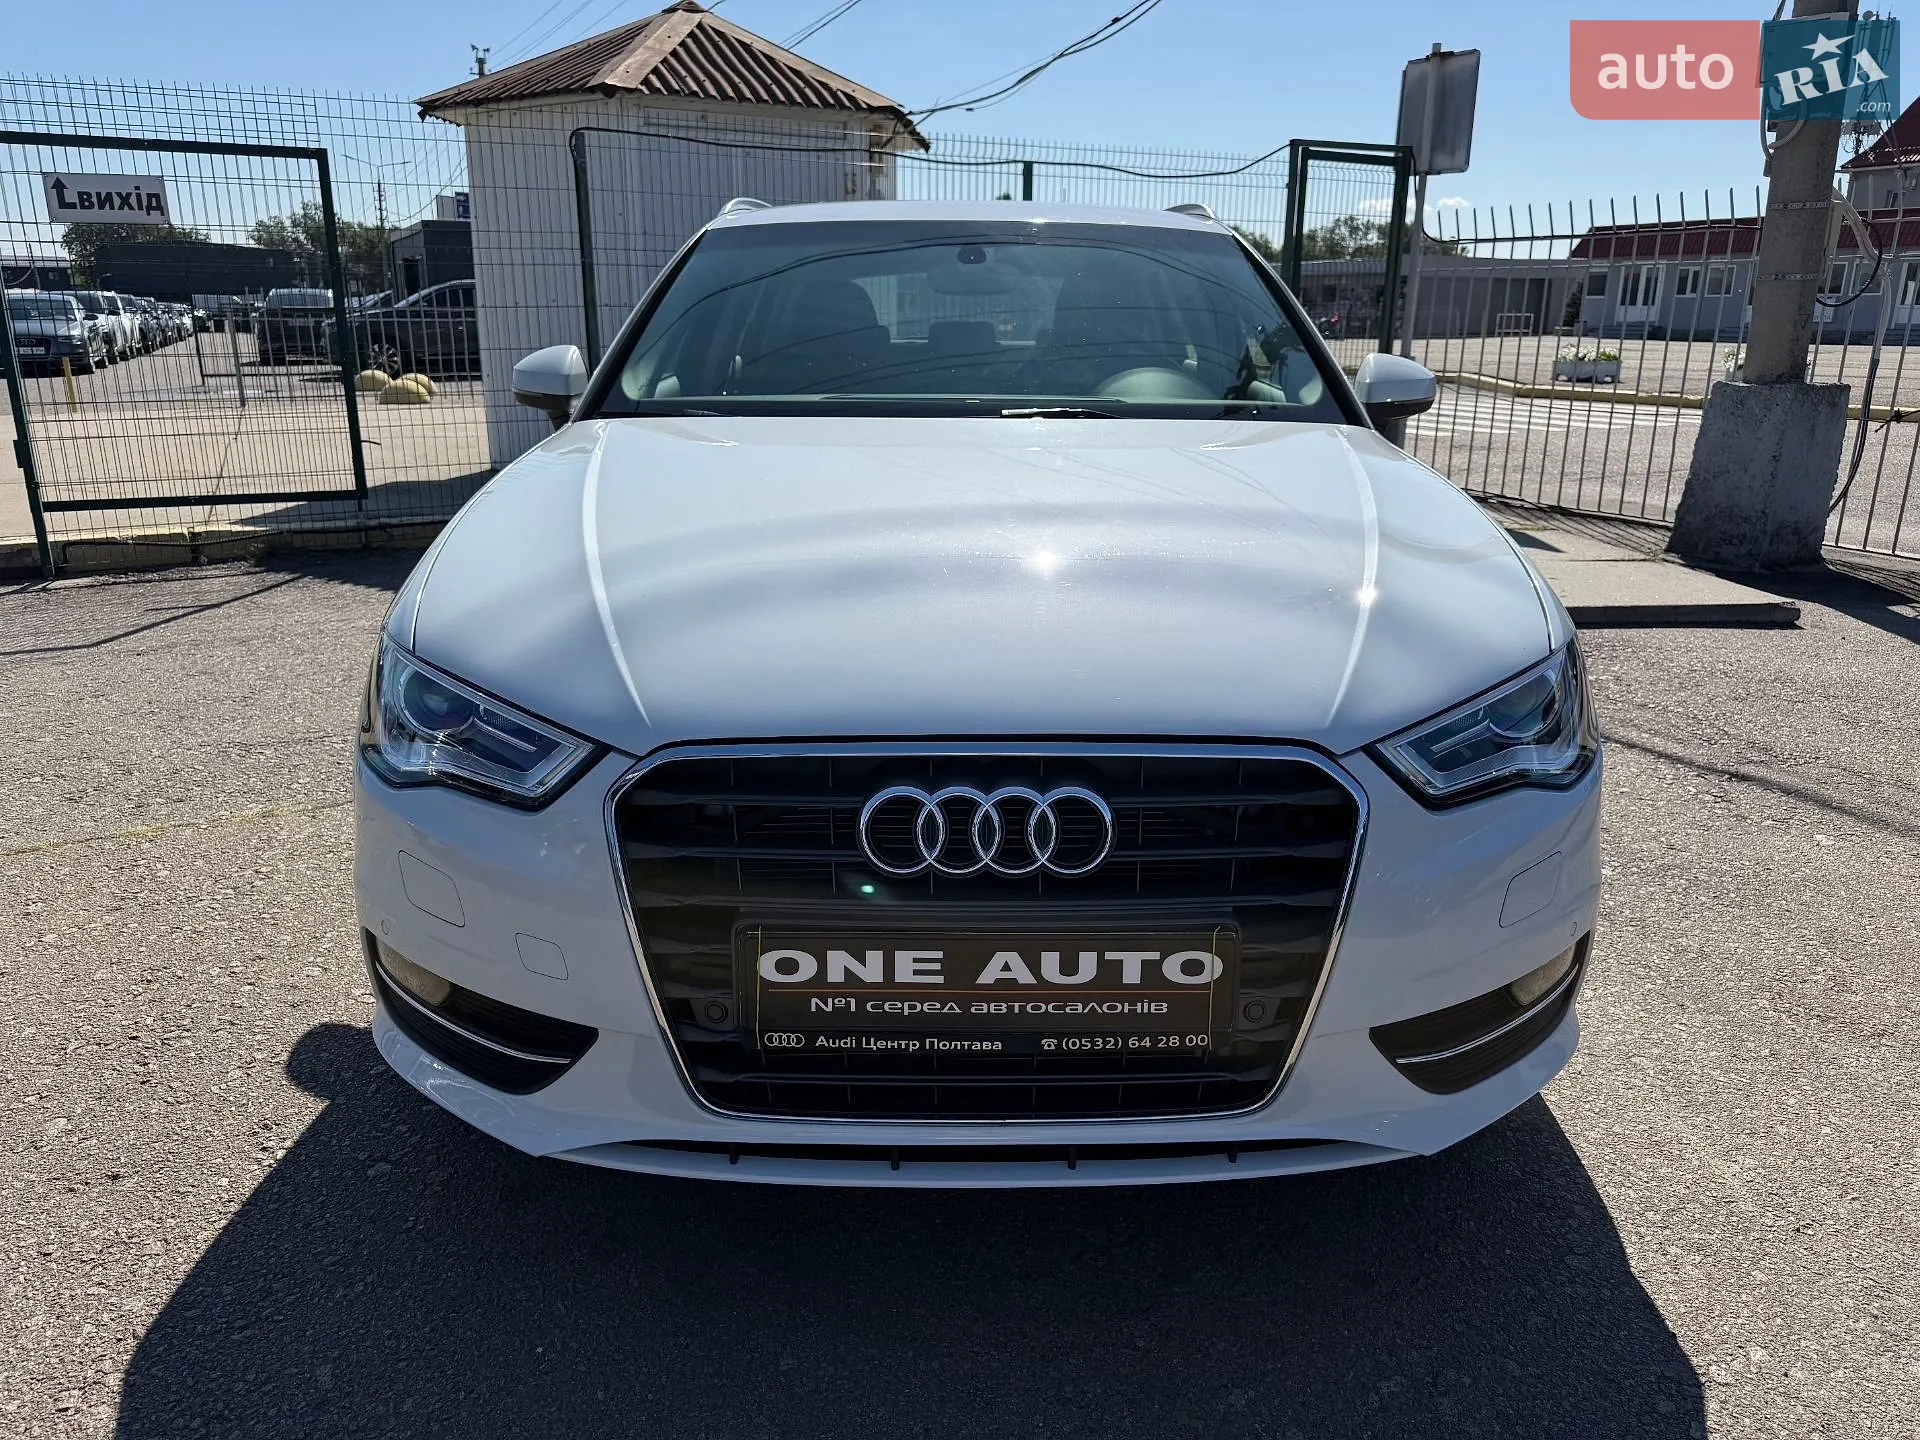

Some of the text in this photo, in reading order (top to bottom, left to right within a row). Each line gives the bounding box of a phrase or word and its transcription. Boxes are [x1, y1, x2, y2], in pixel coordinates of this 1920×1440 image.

[76, 185, 165, 216] вихід
[758, 949, 1224, 985] ONE AUTO
[865, 1001, 963, 1015] серед
[970, 999, 1169, 1014] автосалонів
[815, 1035, 1002, 1051] Audi Центр Полтава
[1062, 1034, 1208, 1050] (0532) 64 28 00
